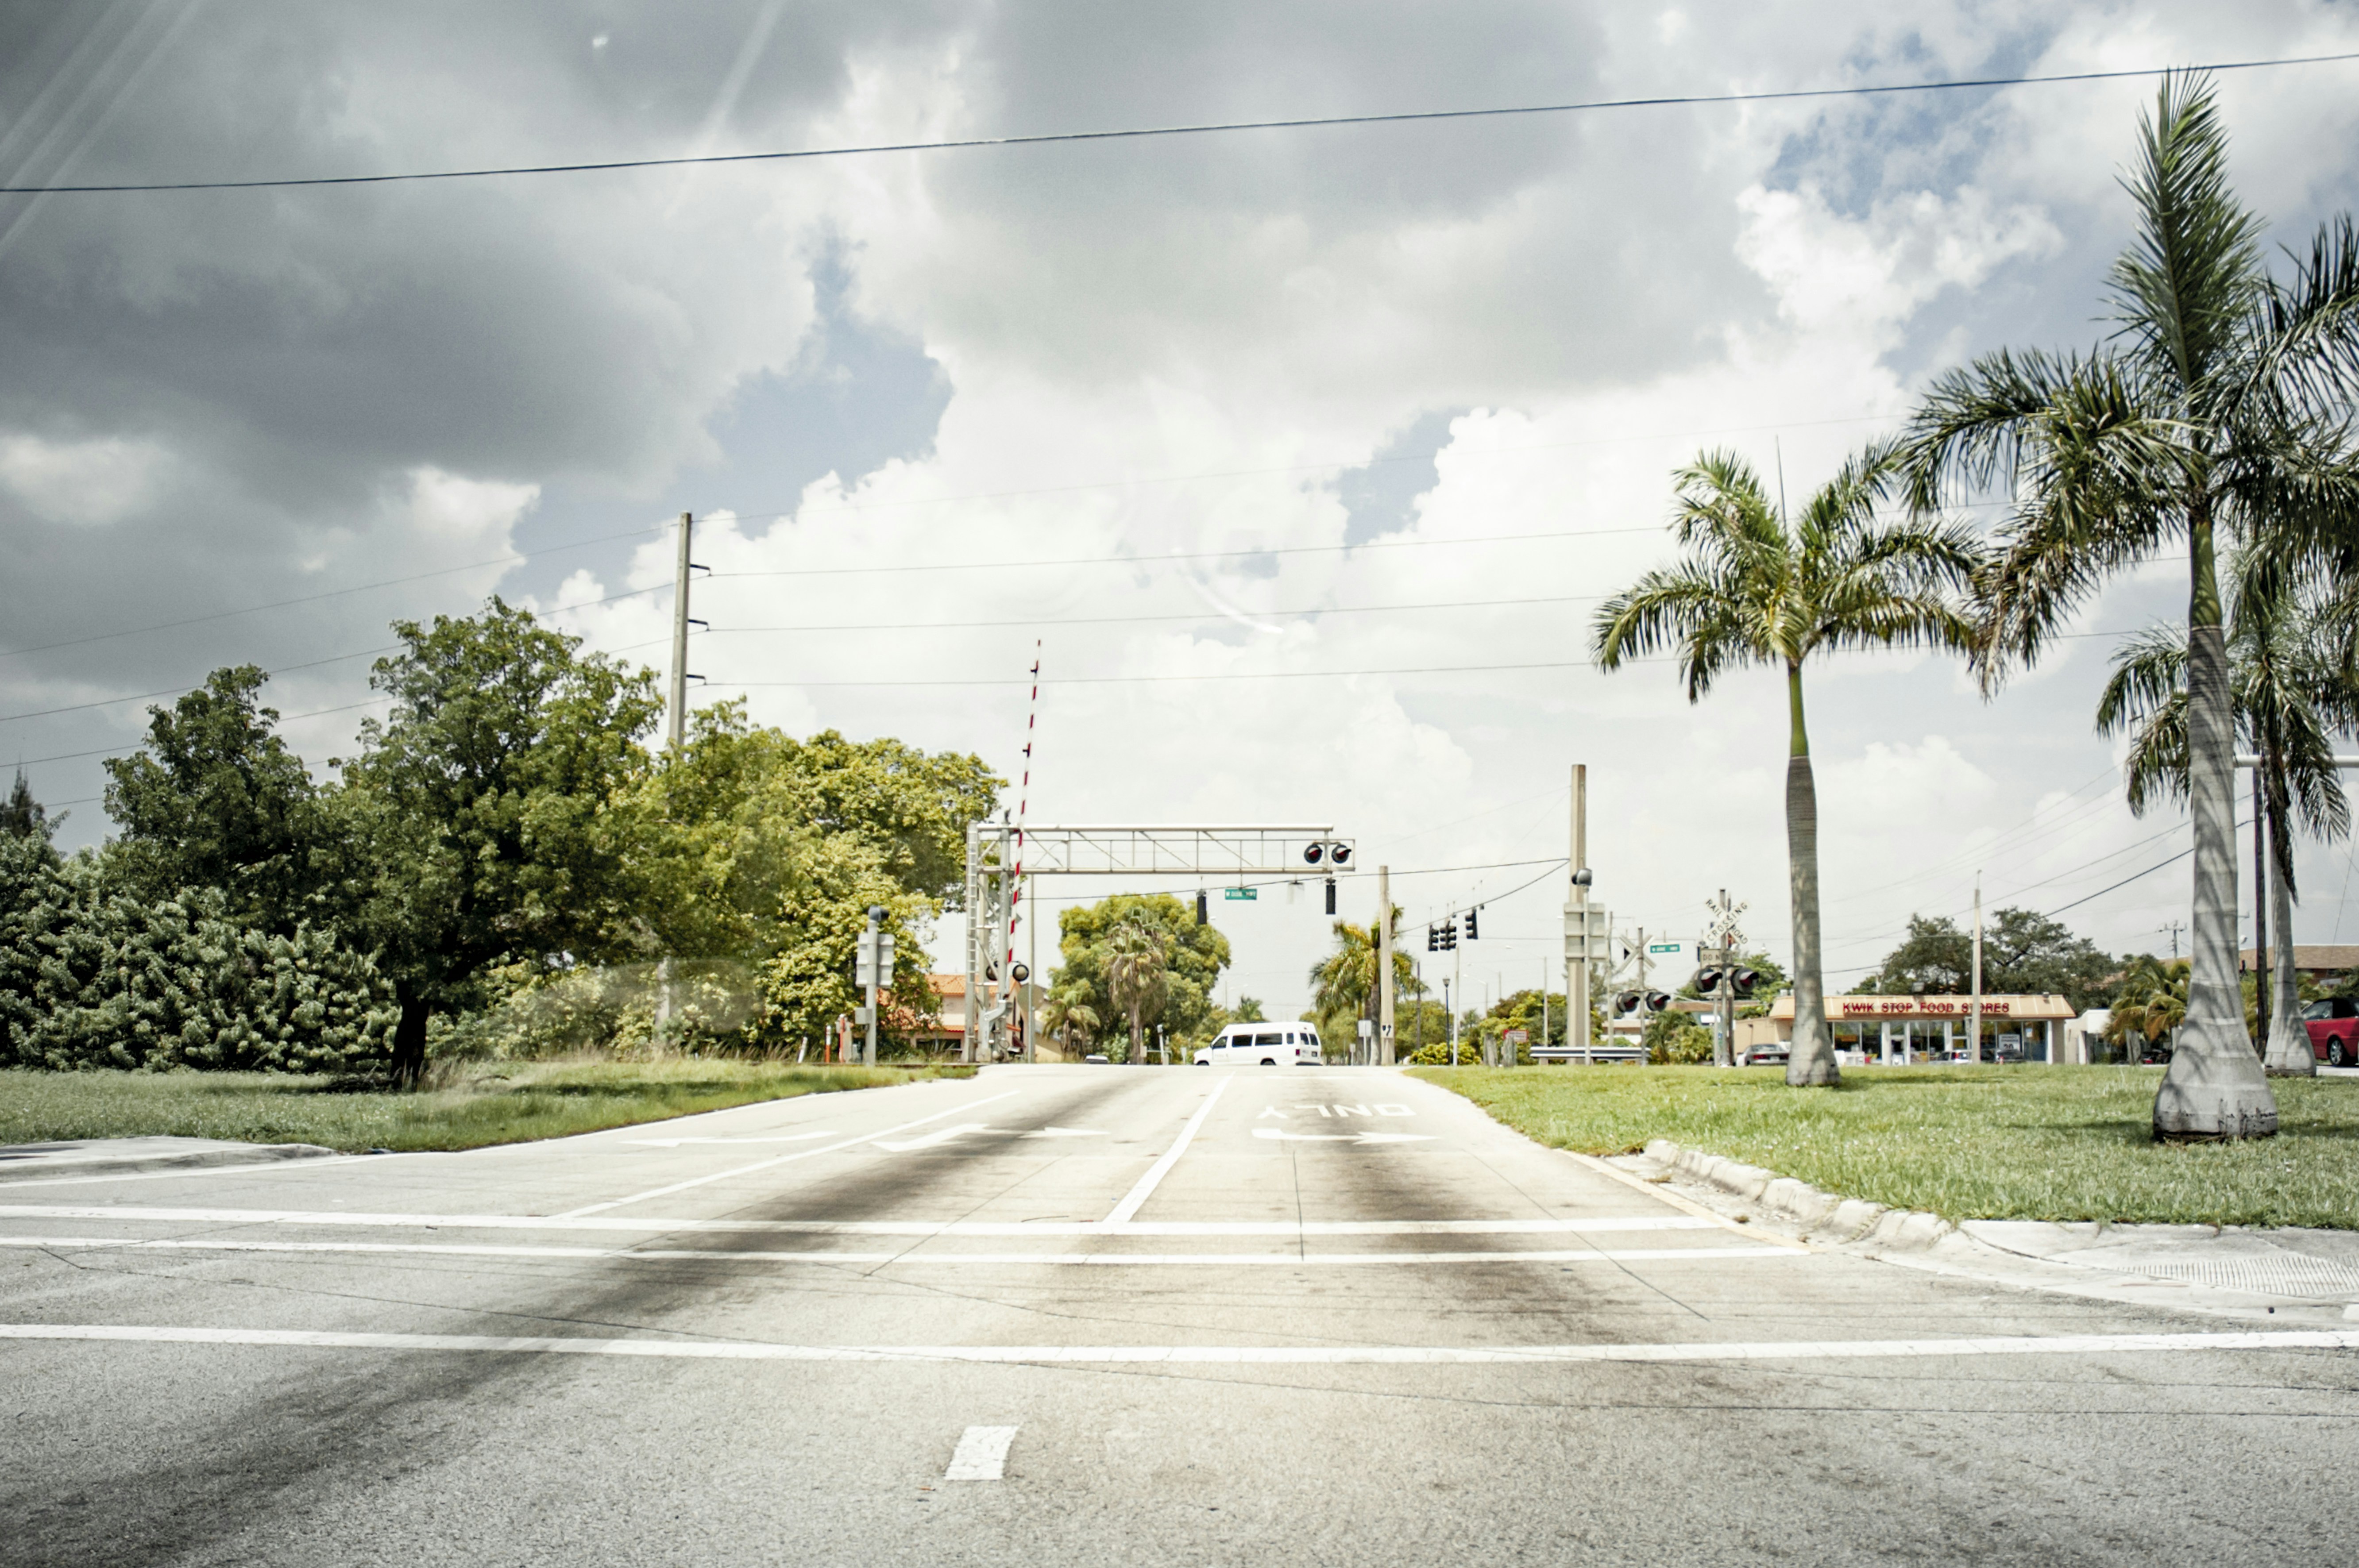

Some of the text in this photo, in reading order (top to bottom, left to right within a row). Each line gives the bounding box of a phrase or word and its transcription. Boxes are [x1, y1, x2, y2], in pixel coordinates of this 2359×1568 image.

[1706, 898, 1722, 918] RAIL
[1707, 902, 1748, 941] CROSSING
[1843, 1002, 1874, 1013] KWIK
[1881, 1002, 1913, 1013] STOP
[1919, 1002, 1954, 1013] FOOD
[1256, 1104, 1417, 1119] ONLY
